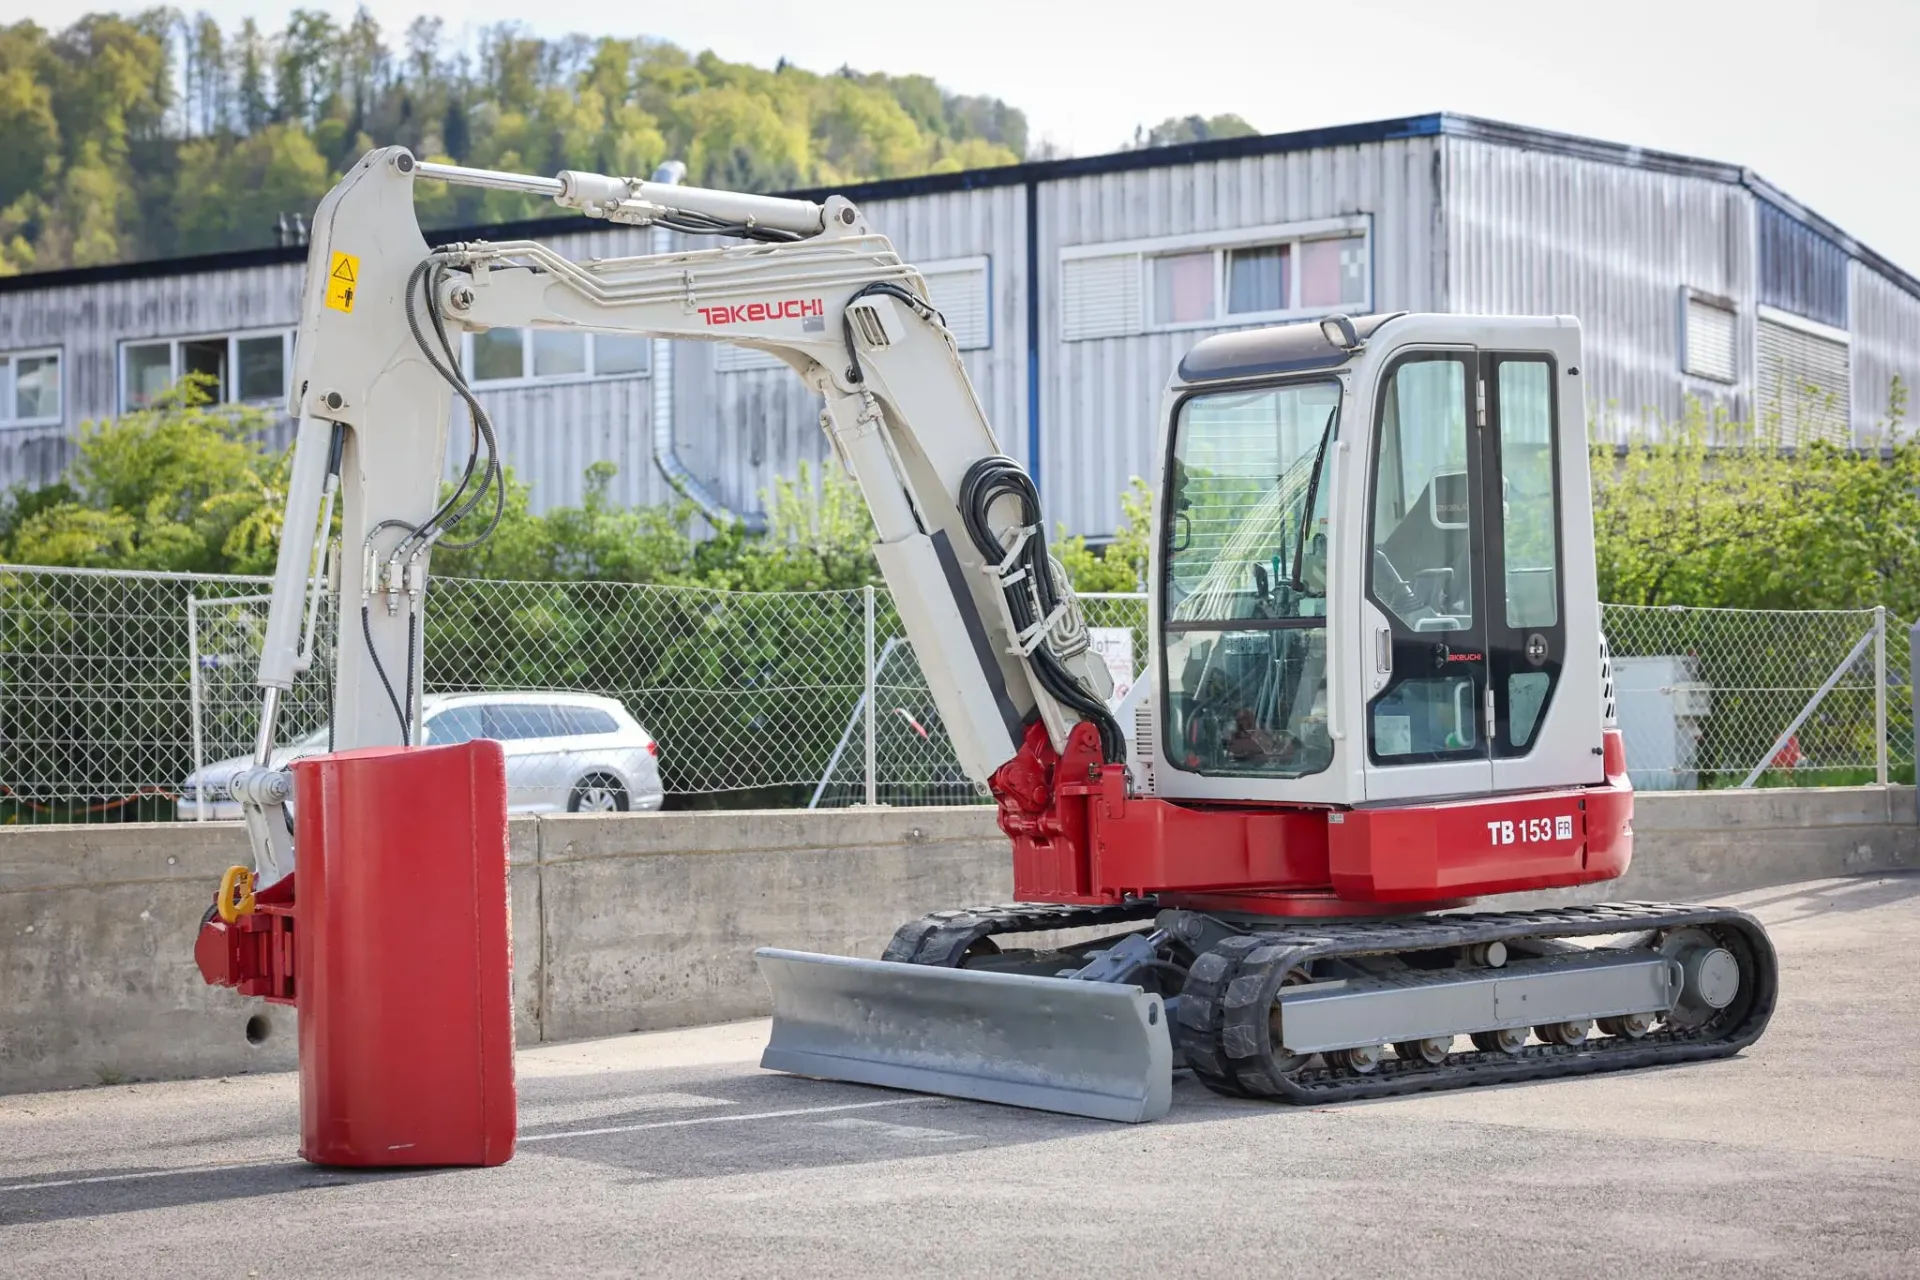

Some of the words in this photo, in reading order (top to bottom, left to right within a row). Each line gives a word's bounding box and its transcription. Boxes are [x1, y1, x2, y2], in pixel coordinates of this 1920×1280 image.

[1447, 653, 1482, 661] AKEUCHI
[1487, 820, 1515, 845] TB
[1519, 817, 1552, 842] 153
[1557, 819, 1571, 837] FR
